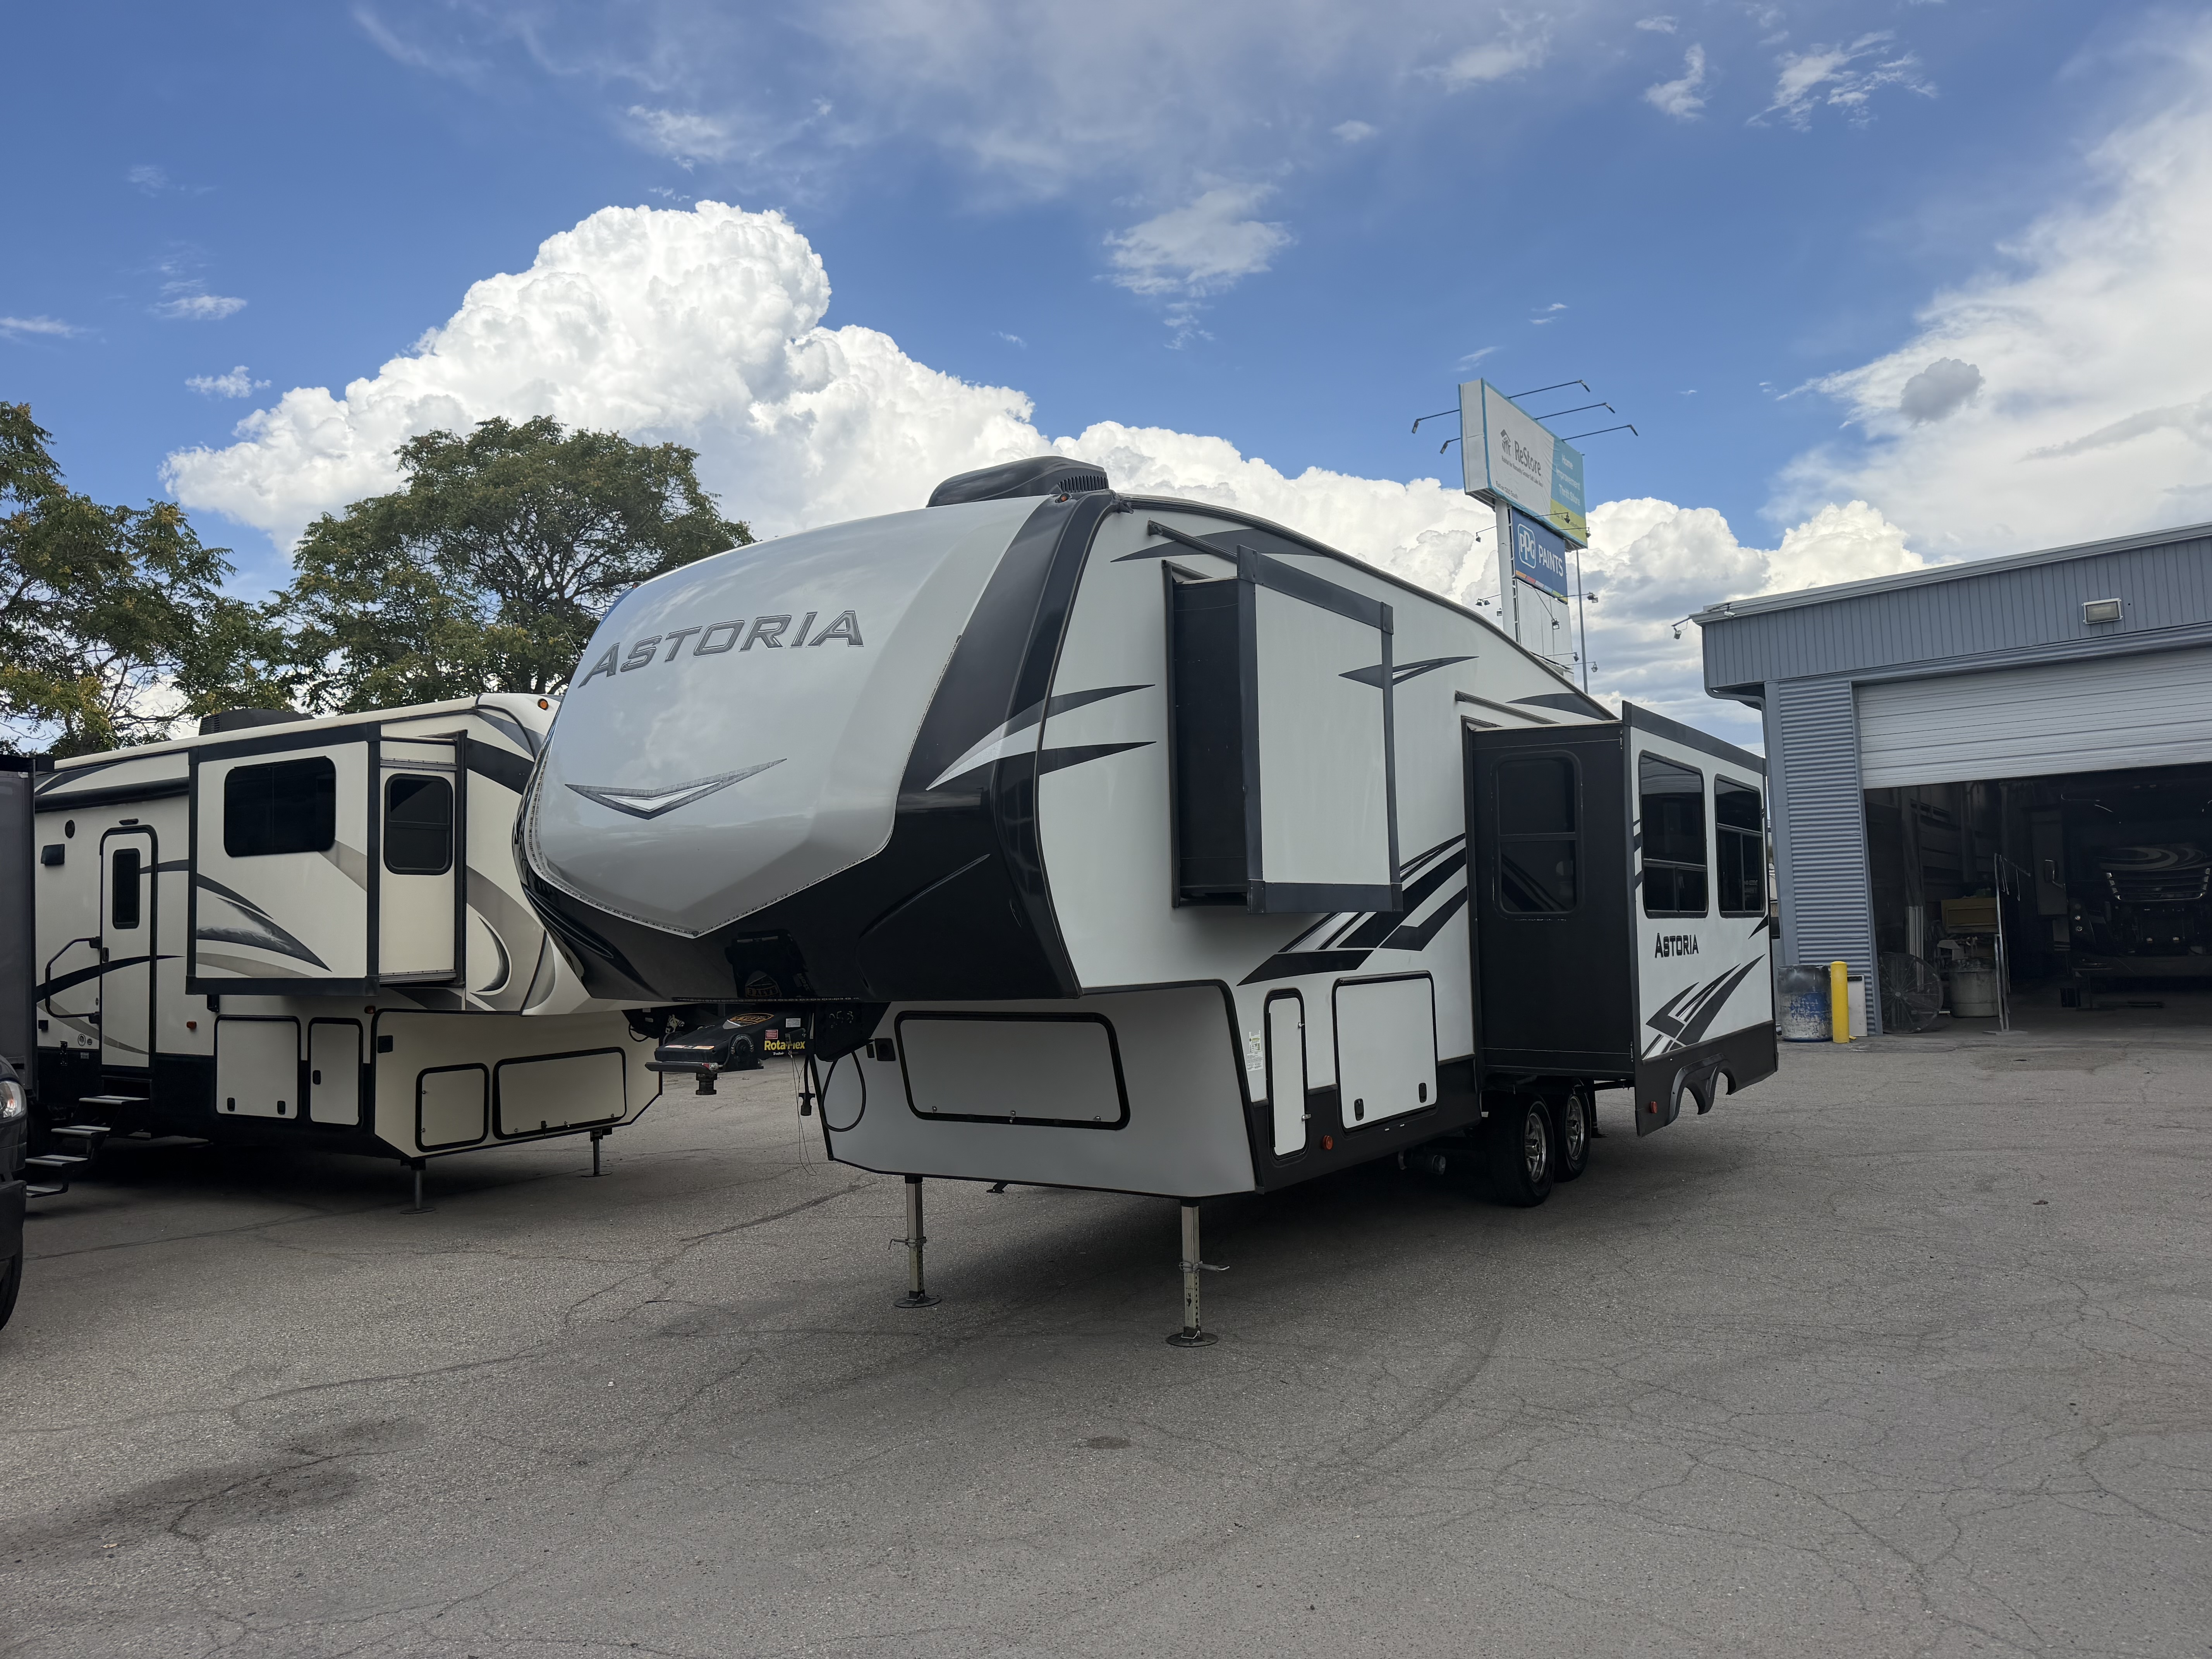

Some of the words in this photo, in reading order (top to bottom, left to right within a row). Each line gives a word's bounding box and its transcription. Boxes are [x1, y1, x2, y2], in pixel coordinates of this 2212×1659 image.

[1515, 440, 1541, 476] ReStore
[1562, 453, 1573, 470] Home
[1556, 465, 1580, 491] Improvement
[1520, 530, 1535, 560] PPG
[1539, 544, 1563, 577] PAINTS
[577, 610, 864, 689] ASTORIA
[1655, 933, 1699, 958] ASTORIA
